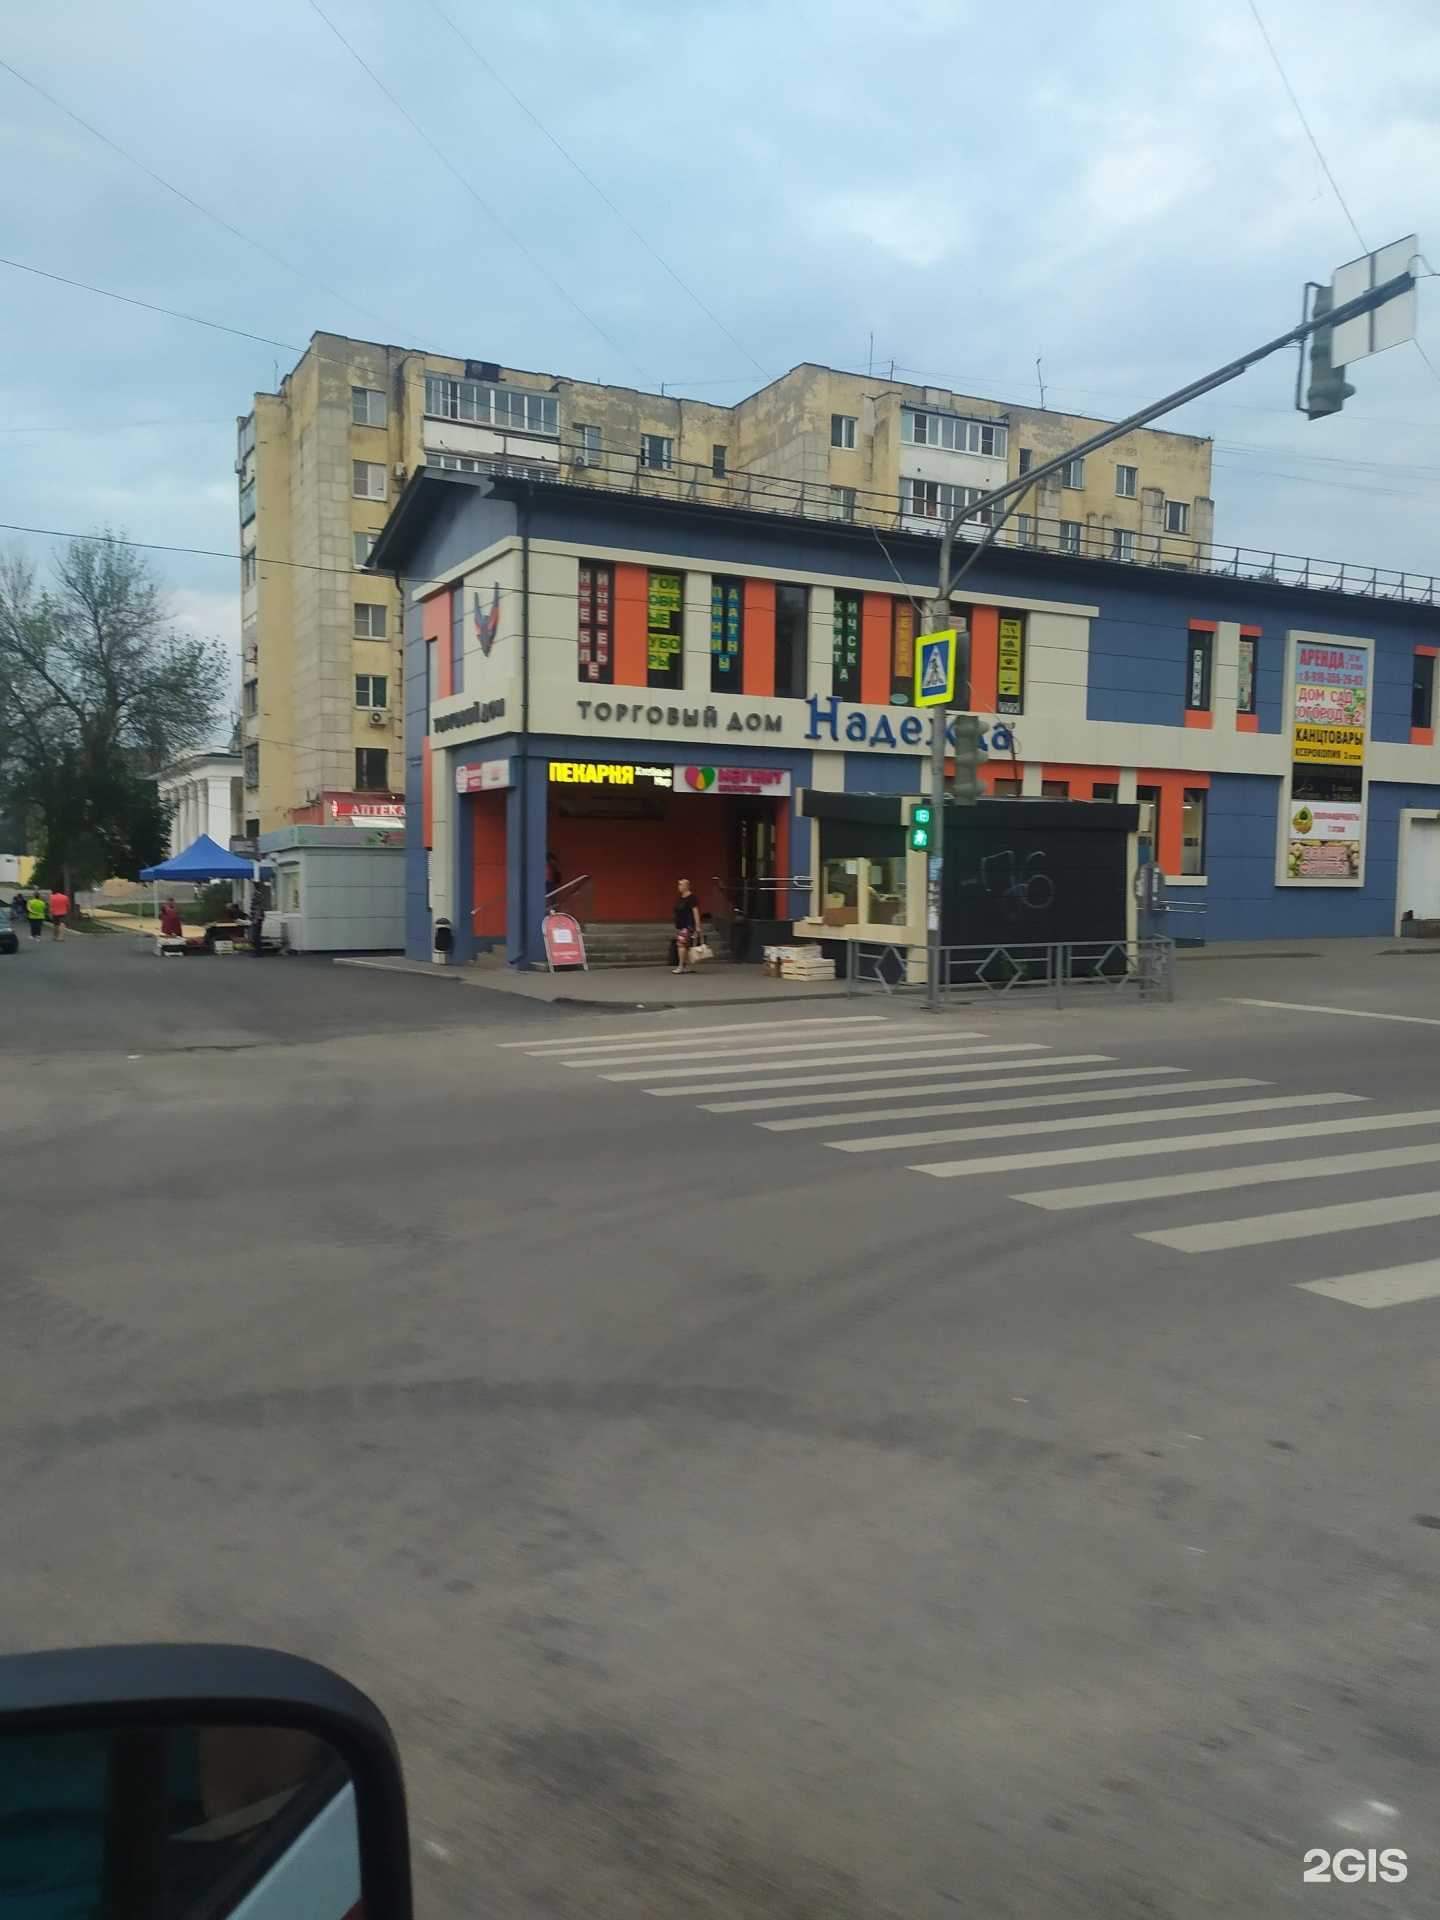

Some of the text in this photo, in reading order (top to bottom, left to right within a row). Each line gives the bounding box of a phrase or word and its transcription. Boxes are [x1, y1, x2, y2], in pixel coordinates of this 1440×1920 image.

[1299, 648, 1345, 670] АРЕНДА
[1299, 688, 1353, 706] ДОМ САД
[577, 700, 783, 734] ТОРГОВЫЙ ДОМ
[1295, 705, 1345, 722] ОГОРОД
[1296, 728, 1364, 746] КАНЦТОВАРЫ
[549, 762, 635, 785] ПЕКАРНЯ
[352, 804, 406, 817] АПТЕКА
